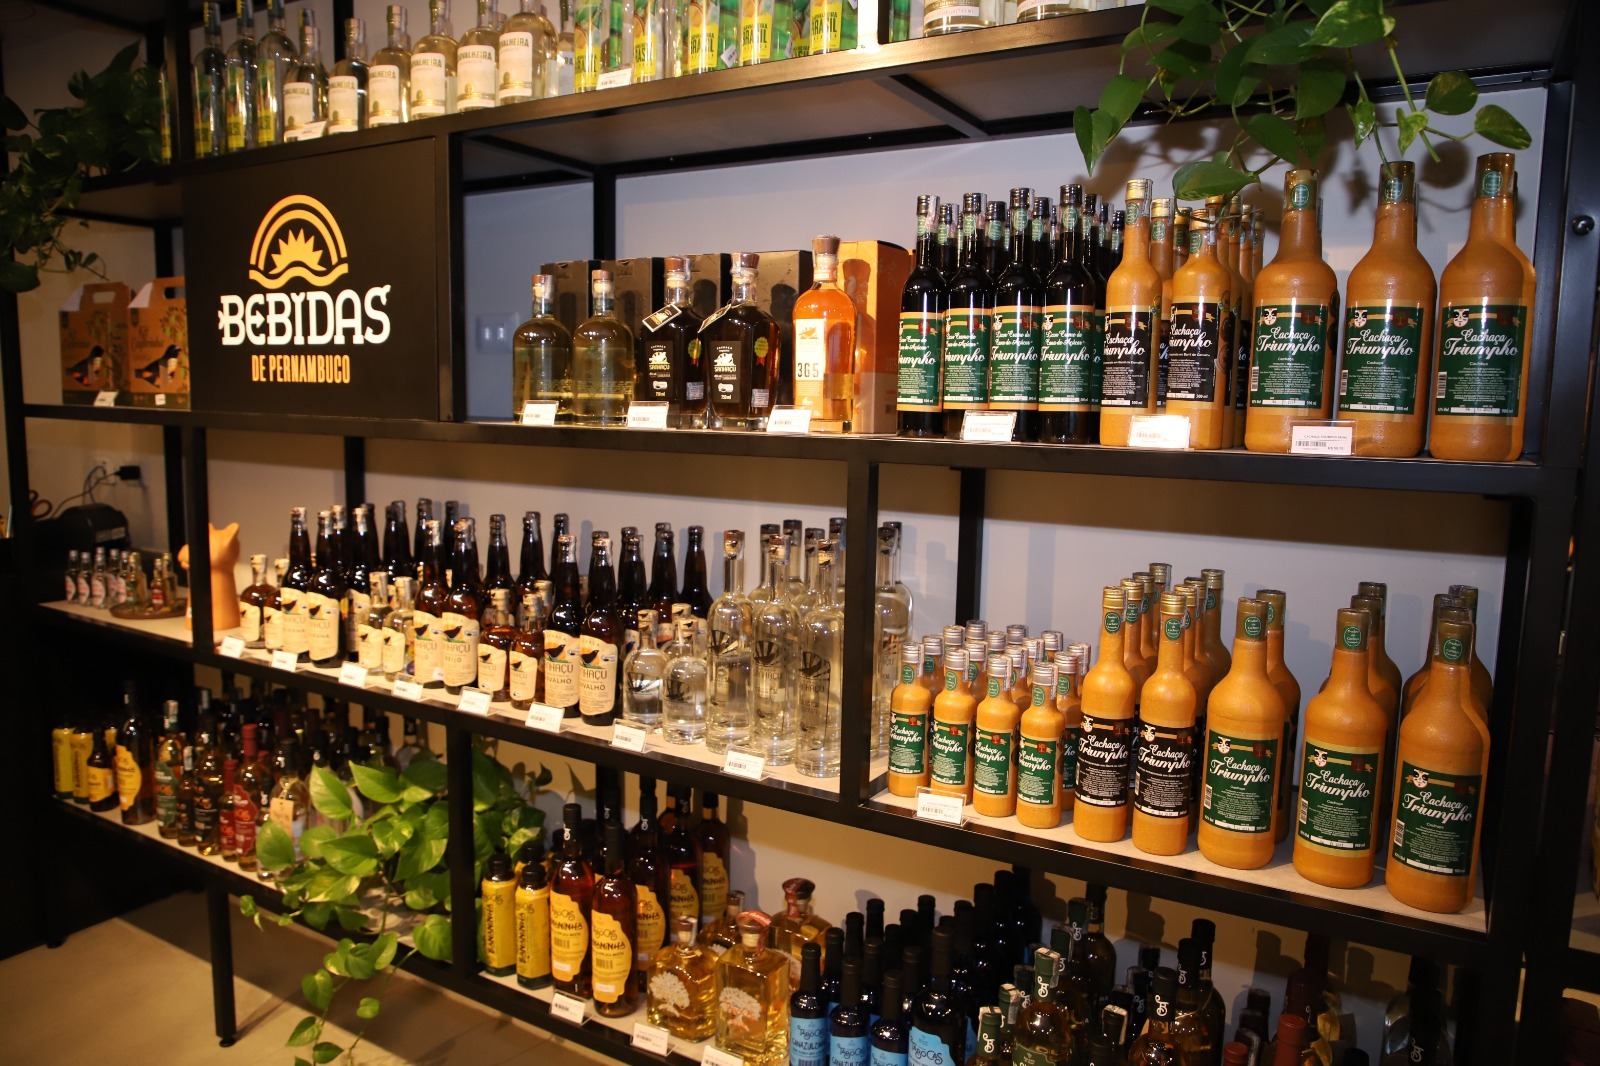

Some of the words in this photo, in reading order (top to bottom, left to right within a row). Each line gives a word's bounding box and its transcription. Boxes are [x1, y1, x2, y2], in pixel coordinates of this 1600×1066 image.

[218, 284, 391, 346] BEBIDAS
[1256, 334, 1321, 356] Triumpho
[1270, 326, 1311, 343] Cachaça
[1360, 328, 1403, 346] Cachaça
[1461, 328, 1508, 346] Cachaça
[1040, 345, 1090, 365] Triumpho
[1346, 337, 1414, 360] Triumpho
[1443, 337, 1519, 360] Triumpho
[251, 355, 267, 382] DE
[269, 354, 350, 384] PERNAMBUCO
[1079, 737, 1129, 763] Triumpho
[1087, 734, 1121, 752] Cachaça
[1149, 743, 1185, 761] Cachaça
[1138, 746, 1191, 773] Triumpho
[1223, 756, 1262, 774] Cachaça
[1209, 759, 1271, 786] Triumpho
[1320, 769, 1361, 788] Cachaça
[1305, 772, 1371, 801] Triumpho
[1402, 793, 1473, 824] Triumpho
[1419, 791, 1463, 811] Cachaça
[518, 912, 527, 964] BANANINHA
